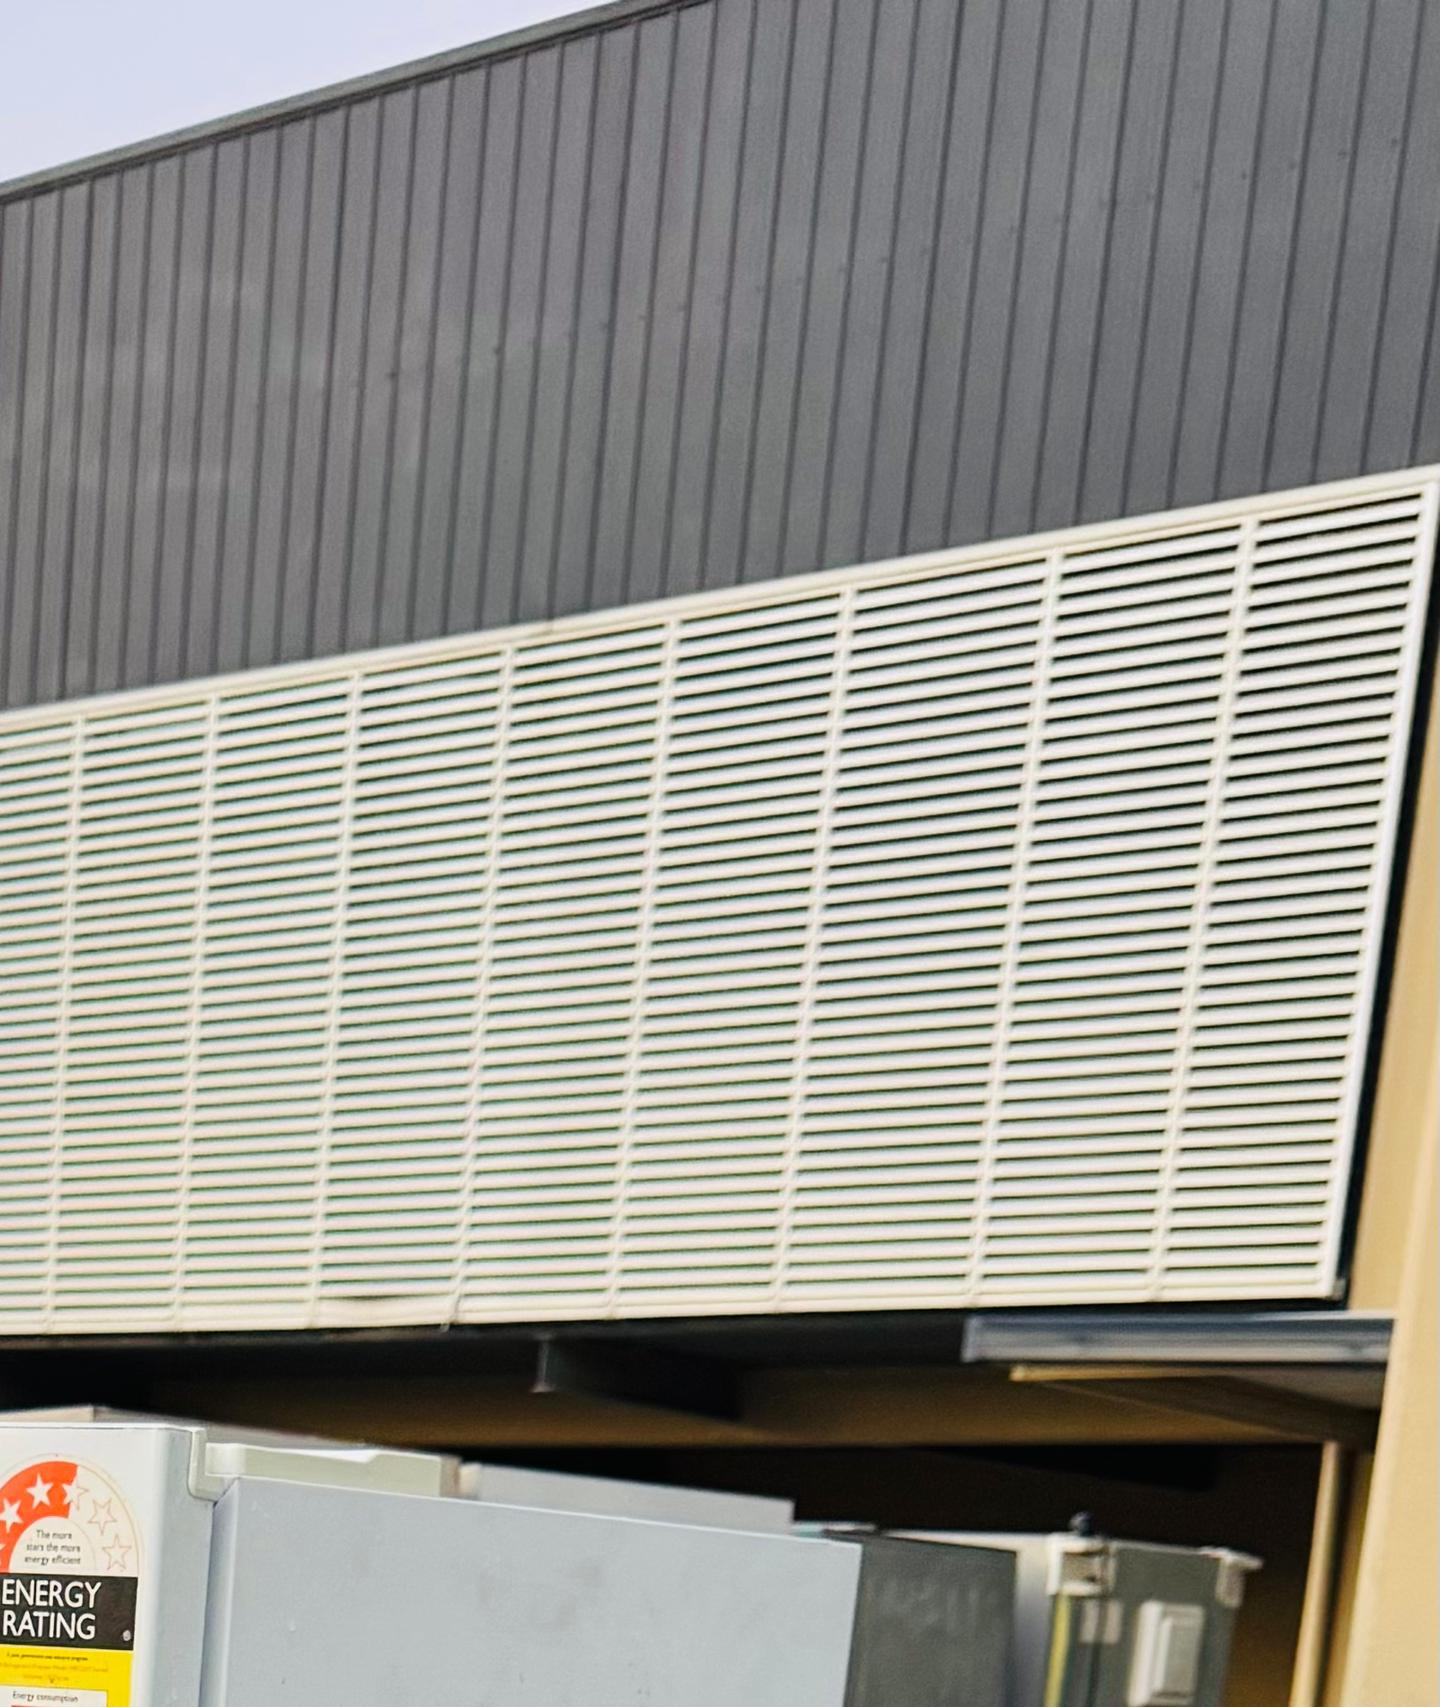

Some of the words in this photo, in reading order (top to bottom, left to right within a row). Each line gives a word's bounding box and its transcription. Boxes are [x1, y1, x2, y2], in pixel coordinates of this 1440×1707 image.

[36, 1529, 50, 1539] The
[52, 1532, 72, 1540] more
[46, 1542, 59, 1552] the
[60, 1544, 81, 1553] more
[24, 1556, 49, 1566] energy
[51, 1555, 81, 1565] efficient
[1, 1579, 102, 1608] ENERGY
[2, 1610, 96, 1639] RATING
[12, 1690, 35, 1702] Energy
[36, 1693, 79, 1703] consumption
